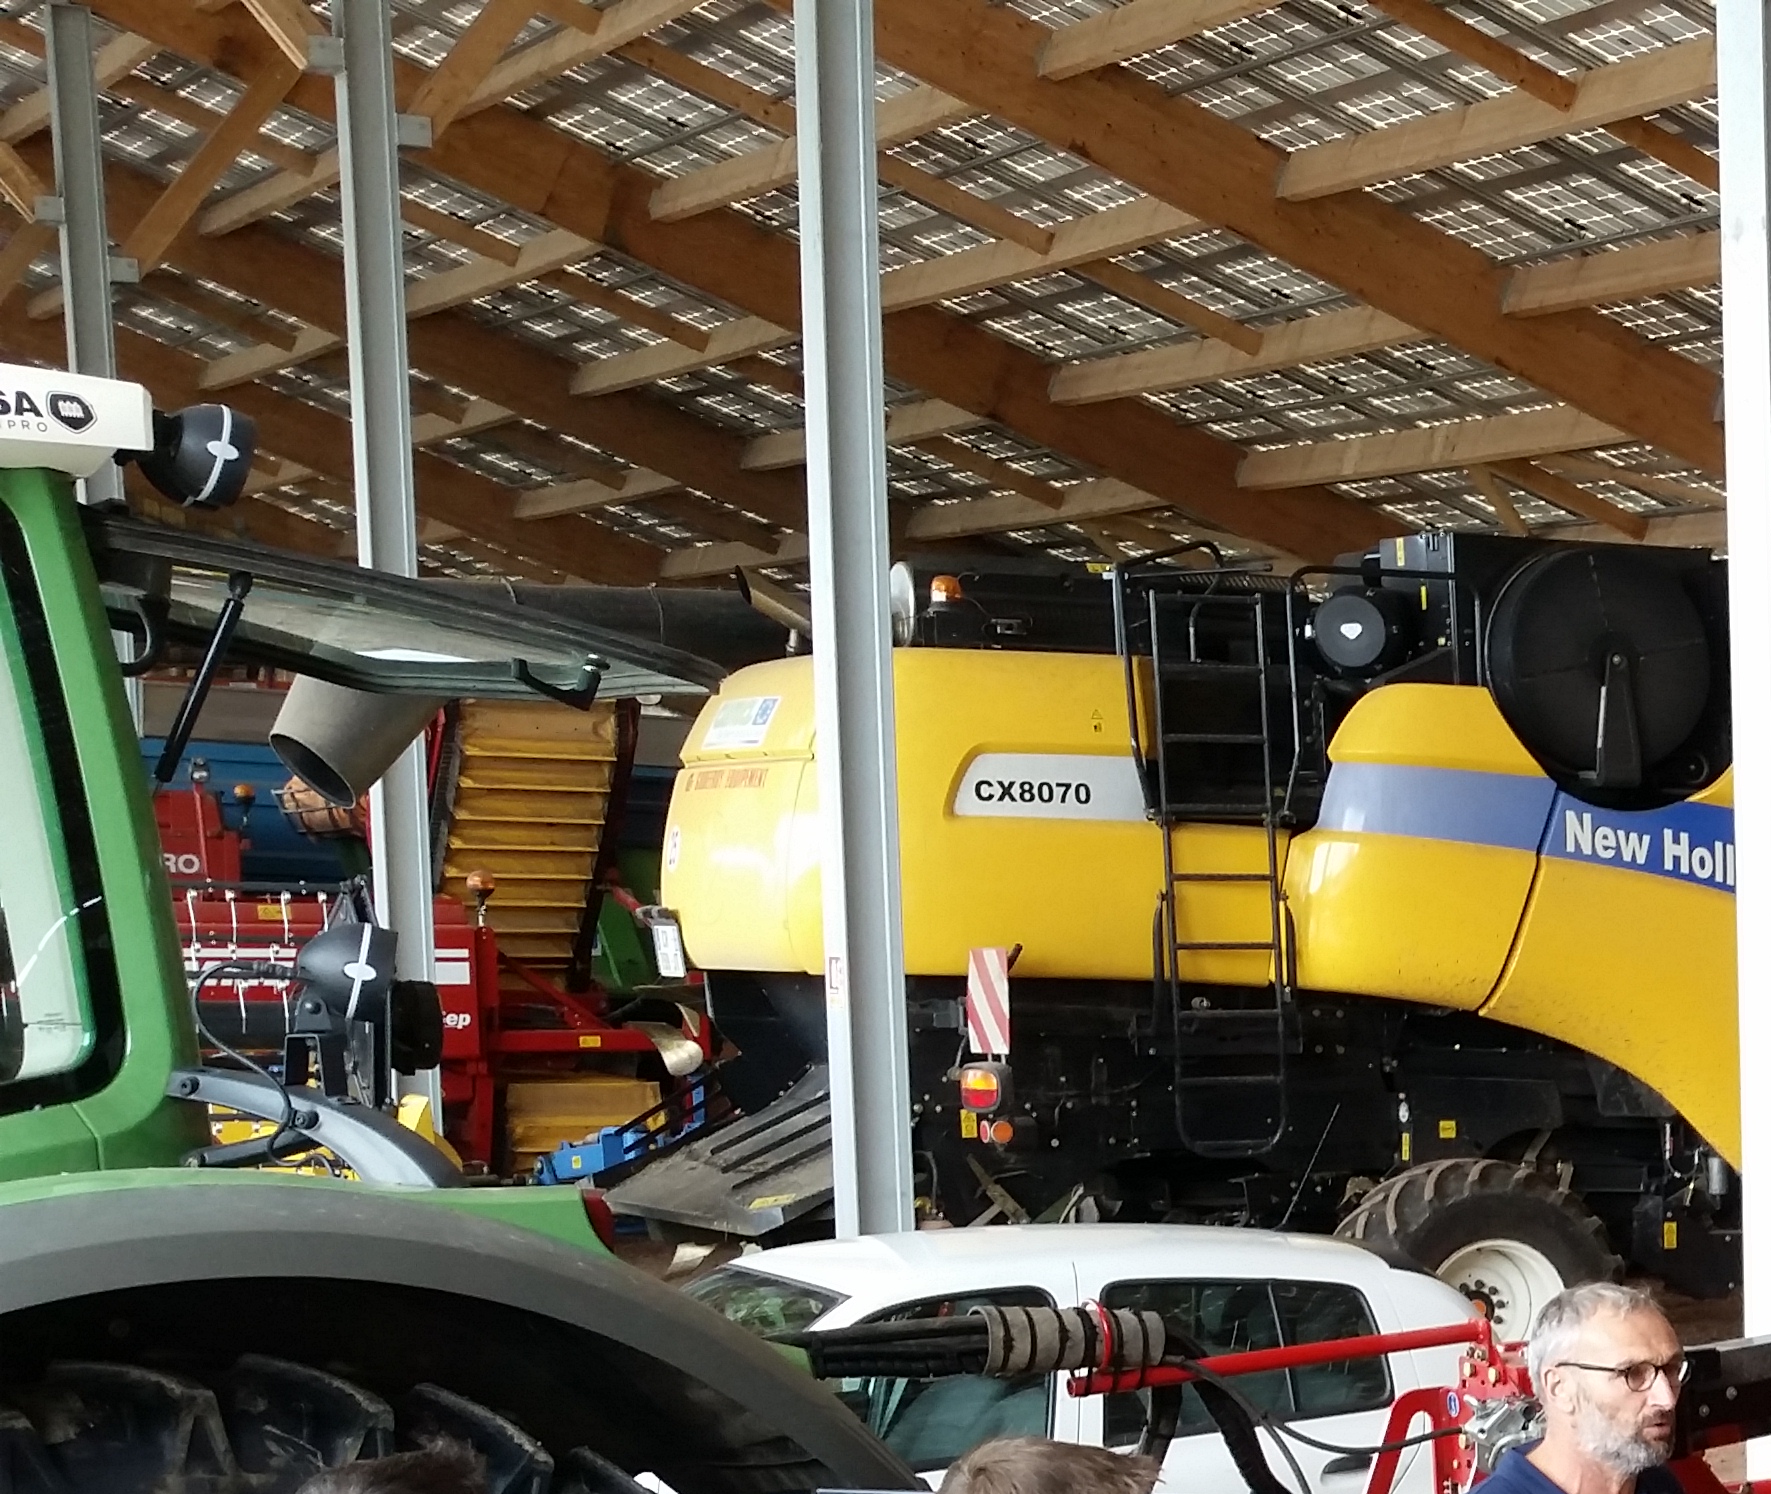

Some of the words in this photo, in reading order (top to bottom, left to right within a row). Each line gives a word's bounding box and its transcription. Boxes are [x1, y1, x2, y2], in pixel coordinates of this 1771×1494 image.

[975, 780, 1091, 805] CX8070
[1565, 810, 1650, 865] New
[1663, 828, 1736, 886] Holl
[163, 853, 201, 874] RO
